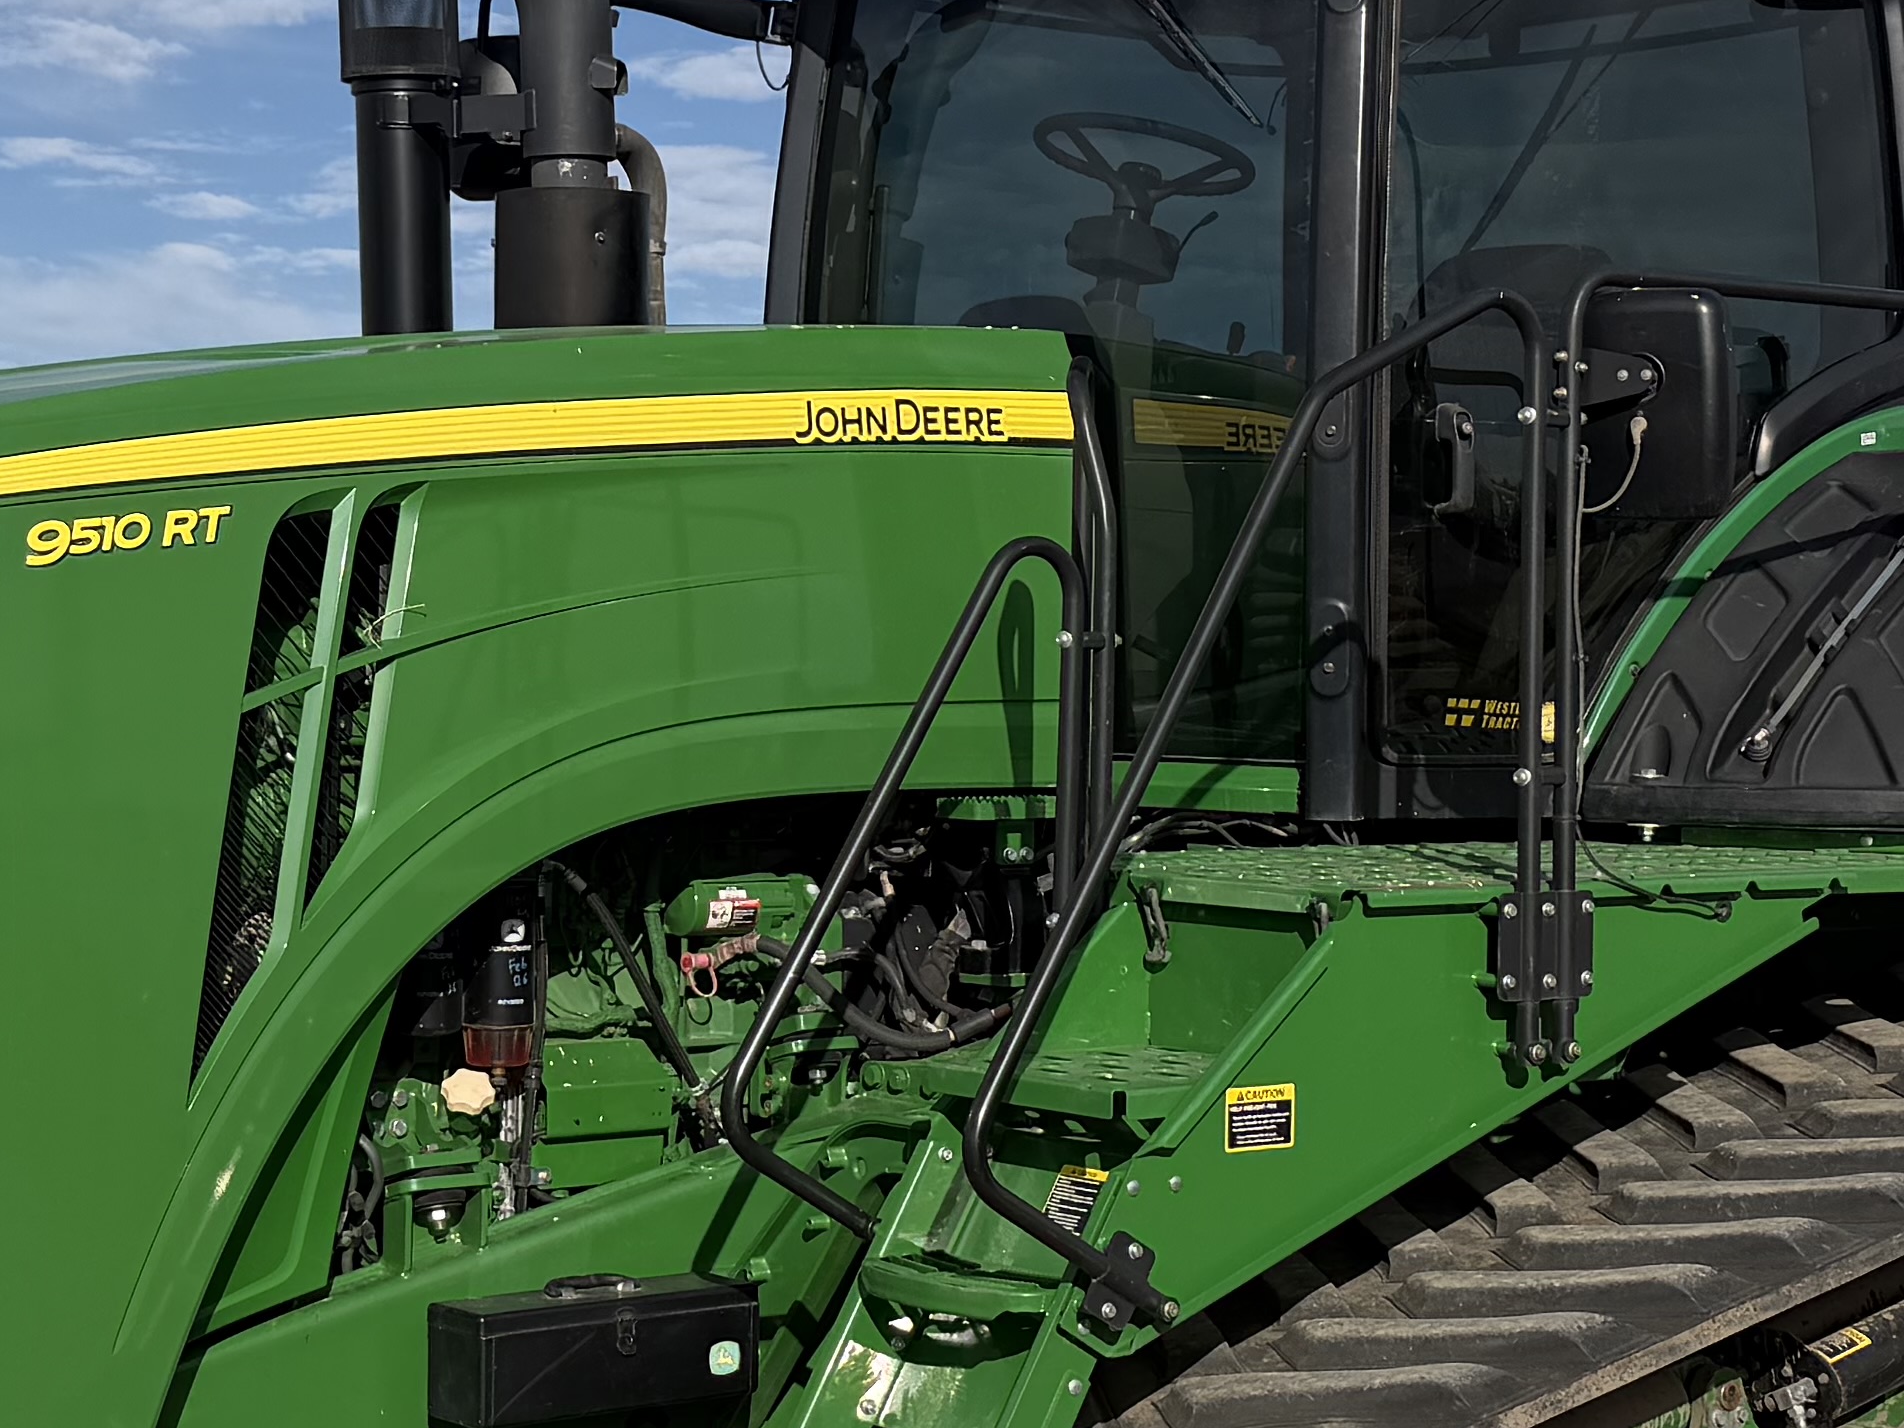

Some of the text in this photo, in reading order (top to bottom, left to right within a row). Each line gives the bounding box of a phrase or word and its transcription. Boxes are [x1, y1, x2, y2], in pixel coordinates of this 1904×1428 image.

[795, 398, 1005, 438] JOHN DEERE
[25, 505, 232, 567] 9510 RT
[508, 956, 528, 974] Feb
[1245, 1088, 1286, 1100] CAUTION
